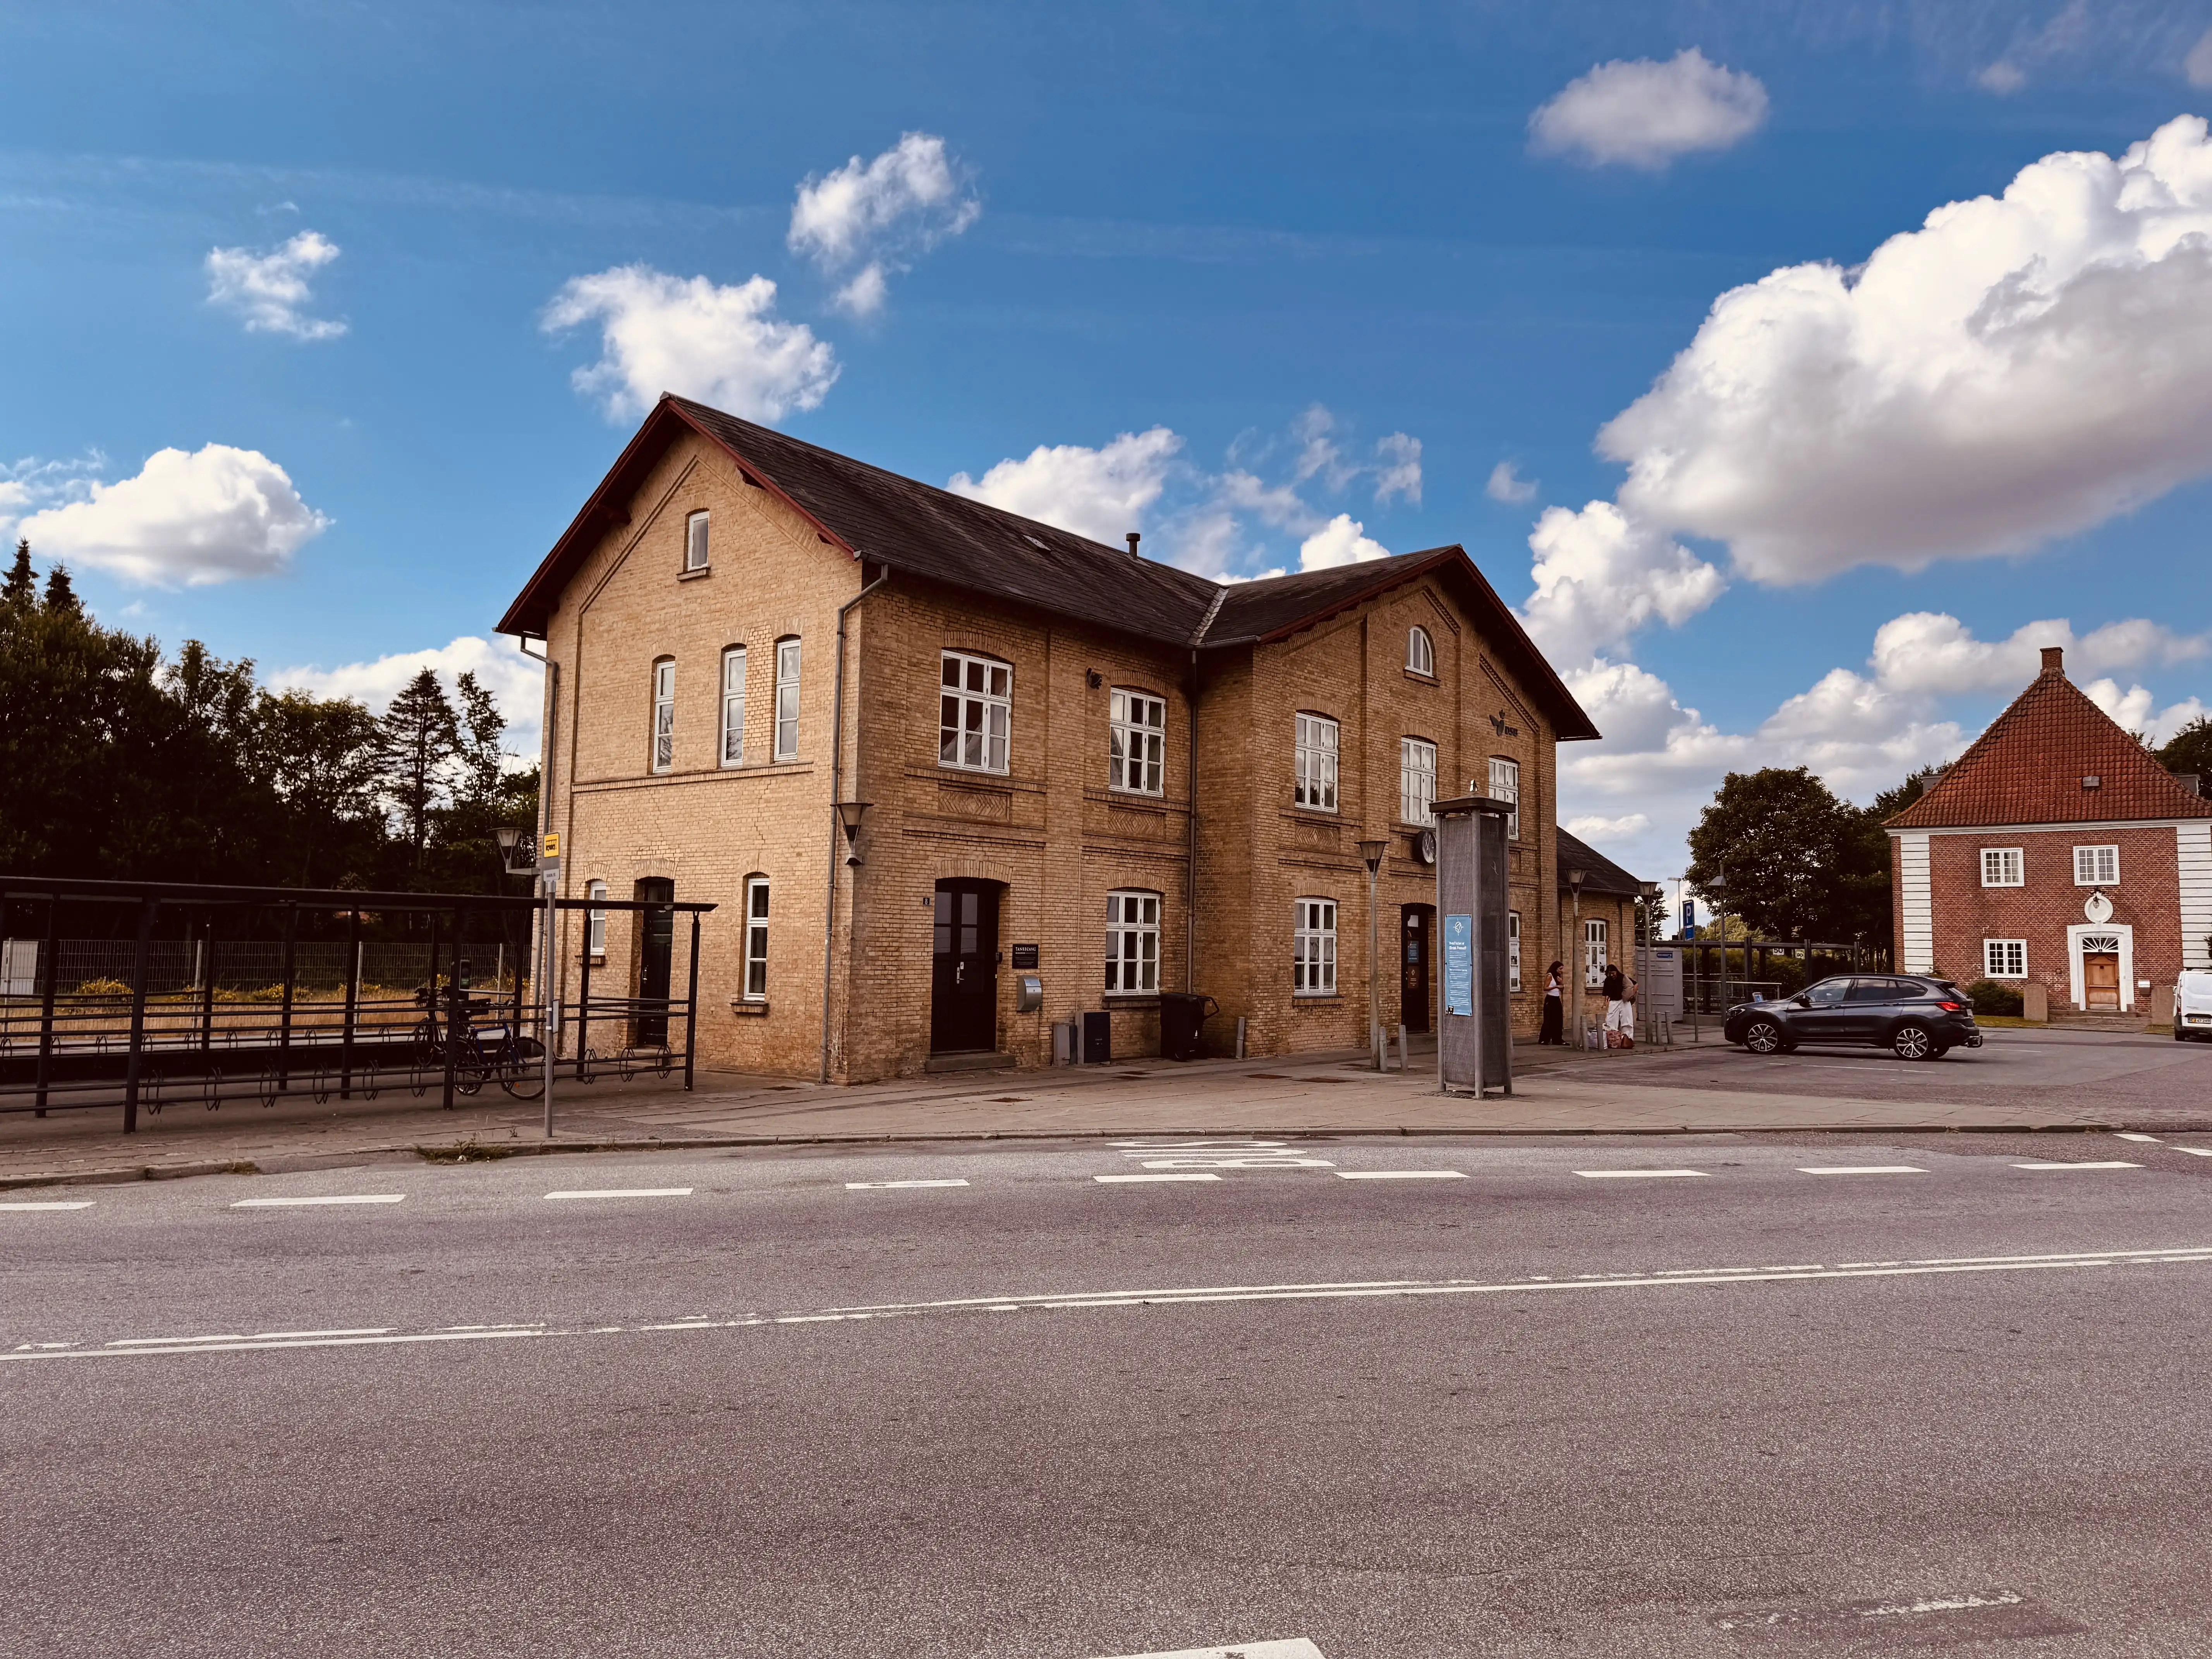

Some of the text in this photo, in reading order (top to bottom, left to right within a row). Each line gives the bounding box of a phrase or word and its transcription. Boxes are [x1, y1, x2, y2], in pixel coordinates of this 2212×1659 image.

[1505, 726, 1518, 737] DSB
[1686, 905, 1691, 924] P
[1105, 1140, 1337, 1168] BUS
